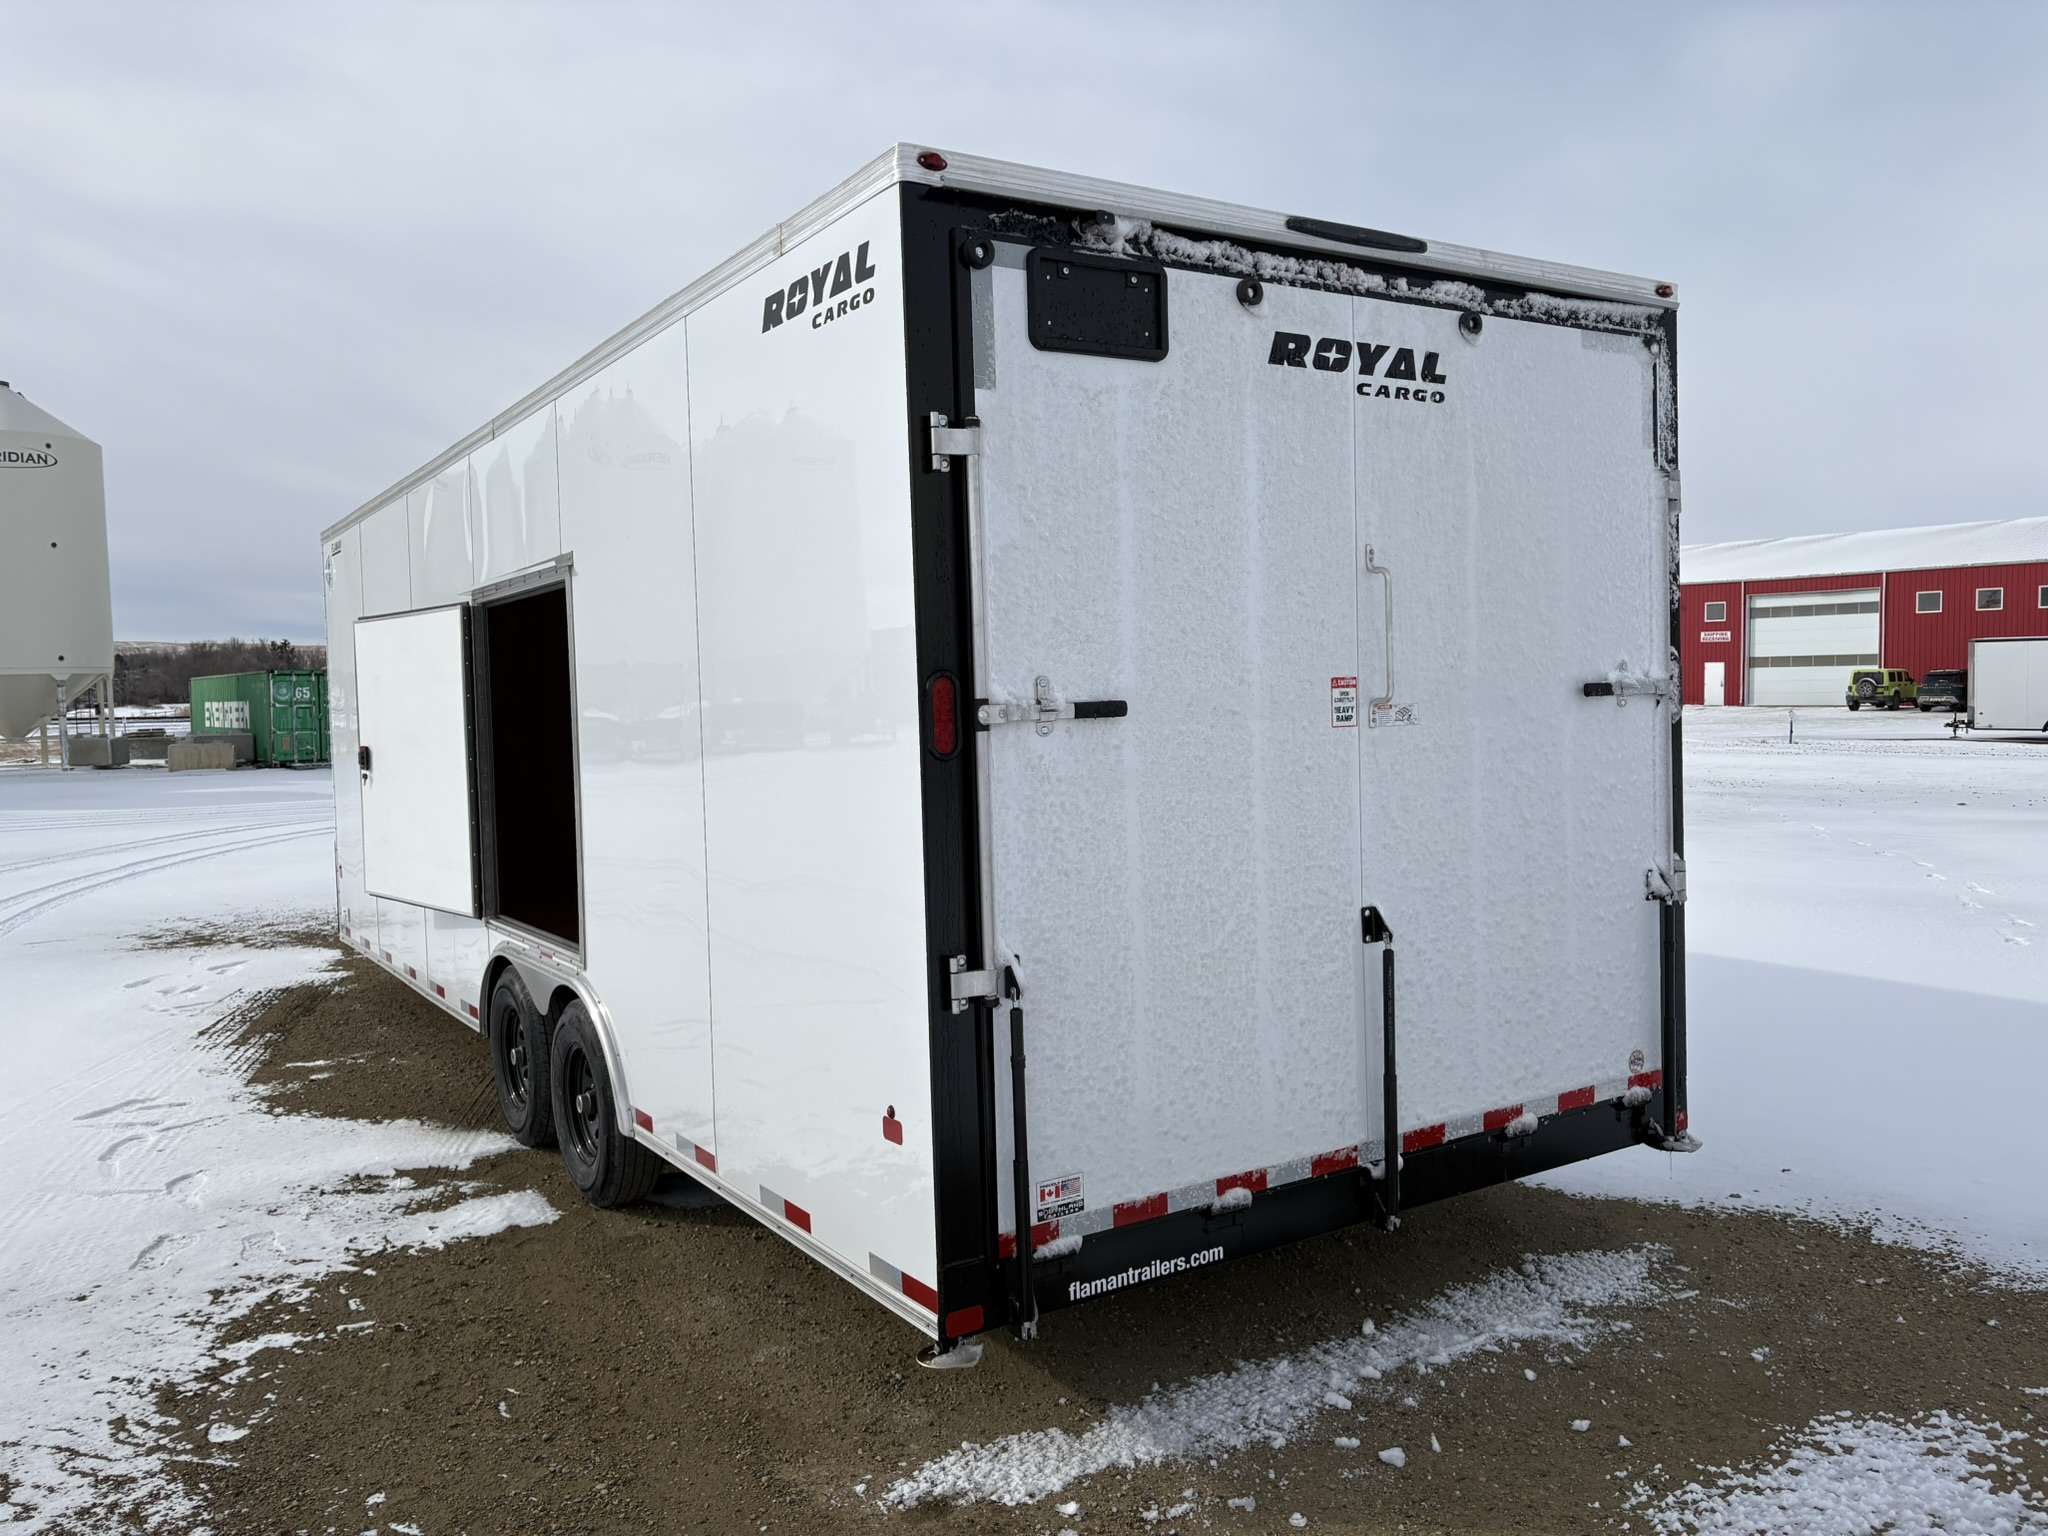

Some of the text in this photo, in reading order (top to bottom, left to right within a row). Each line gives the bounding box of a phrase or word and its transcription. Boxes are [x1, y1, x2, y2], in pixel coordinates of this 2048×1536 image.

[762, 240, 876, 334] ROYAL
[812, 287, 875, 330] CARGO
[1268, 331, 1447, 385] ROYAL
[1356, 382, 1446, 404] CARGO
[0, 451, 48, 465] IDIAN
[295, 686, 311, 699] 65
[1334, 706, 1354, 714] HEAVY
[1068, 1246, 1225, 1301] flamantrailers.com
